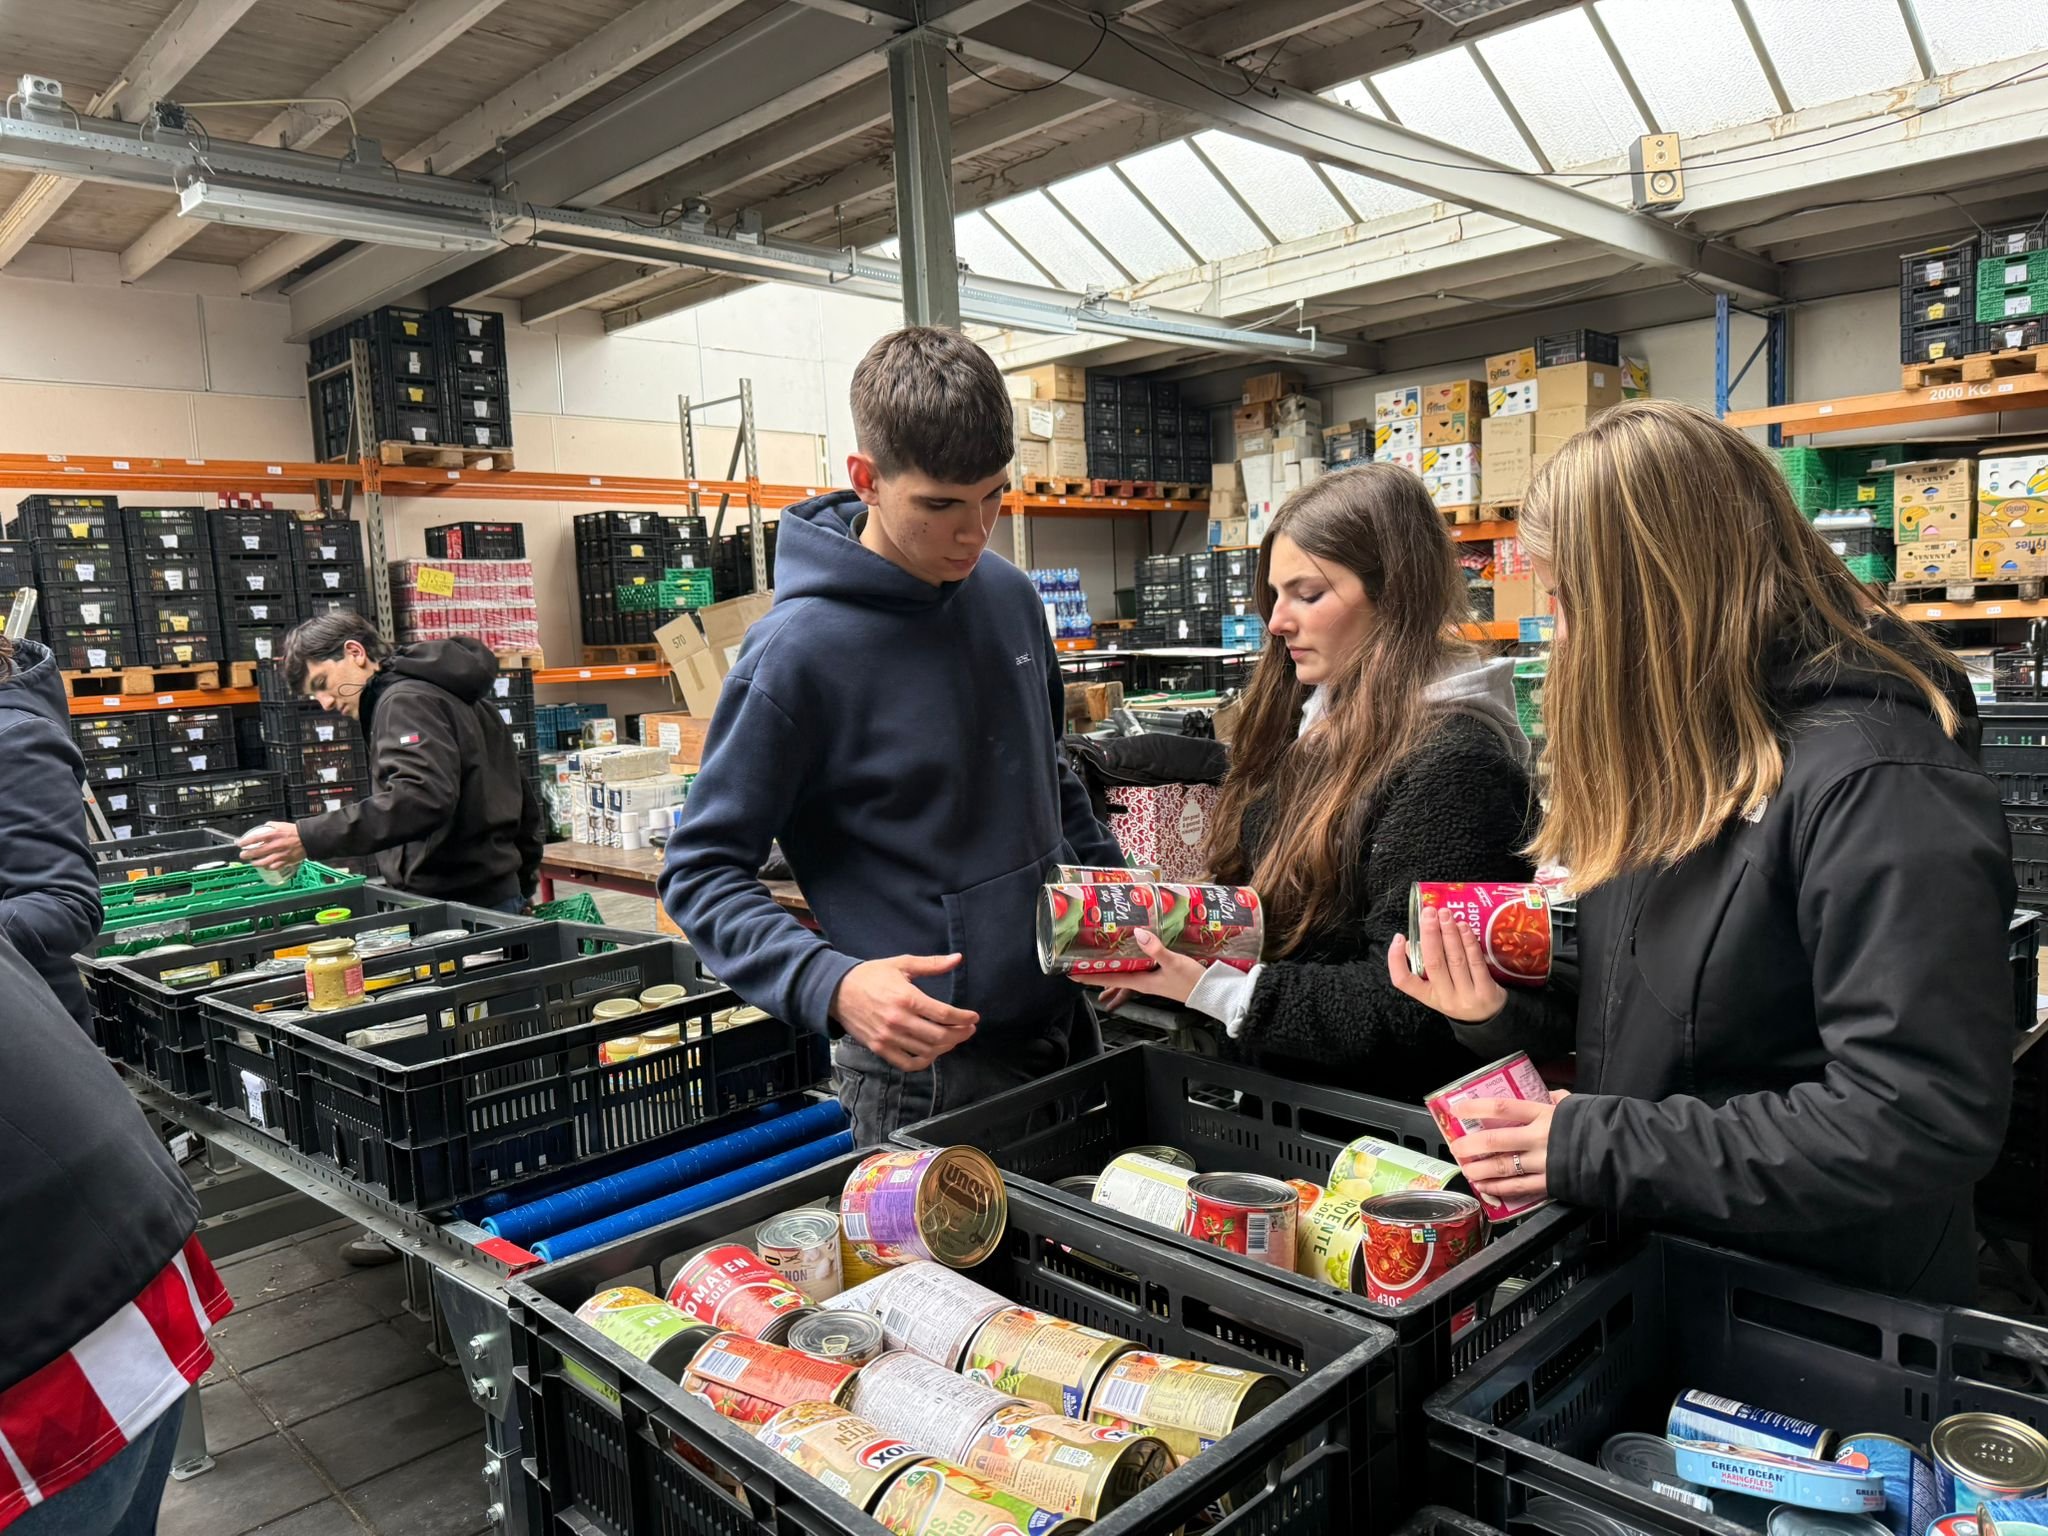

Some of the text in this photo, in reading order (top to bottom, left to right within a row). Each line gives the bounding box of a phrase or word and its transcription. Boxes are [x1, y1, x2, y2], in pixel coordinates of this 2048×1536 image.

[1929, 386, 1964, 400] 2000
[672, 633, 687, 649] 570
[1313, 1202, 1334, 1226] SOEP
[1313, 1199, 1360, 1257] ROENTE
[686, 1258, 750, 1316] OMATEN
[705, 1278, 732, 1307] SOEP
[1711, 1460, 1784, 1482] GREAT OCEAN
